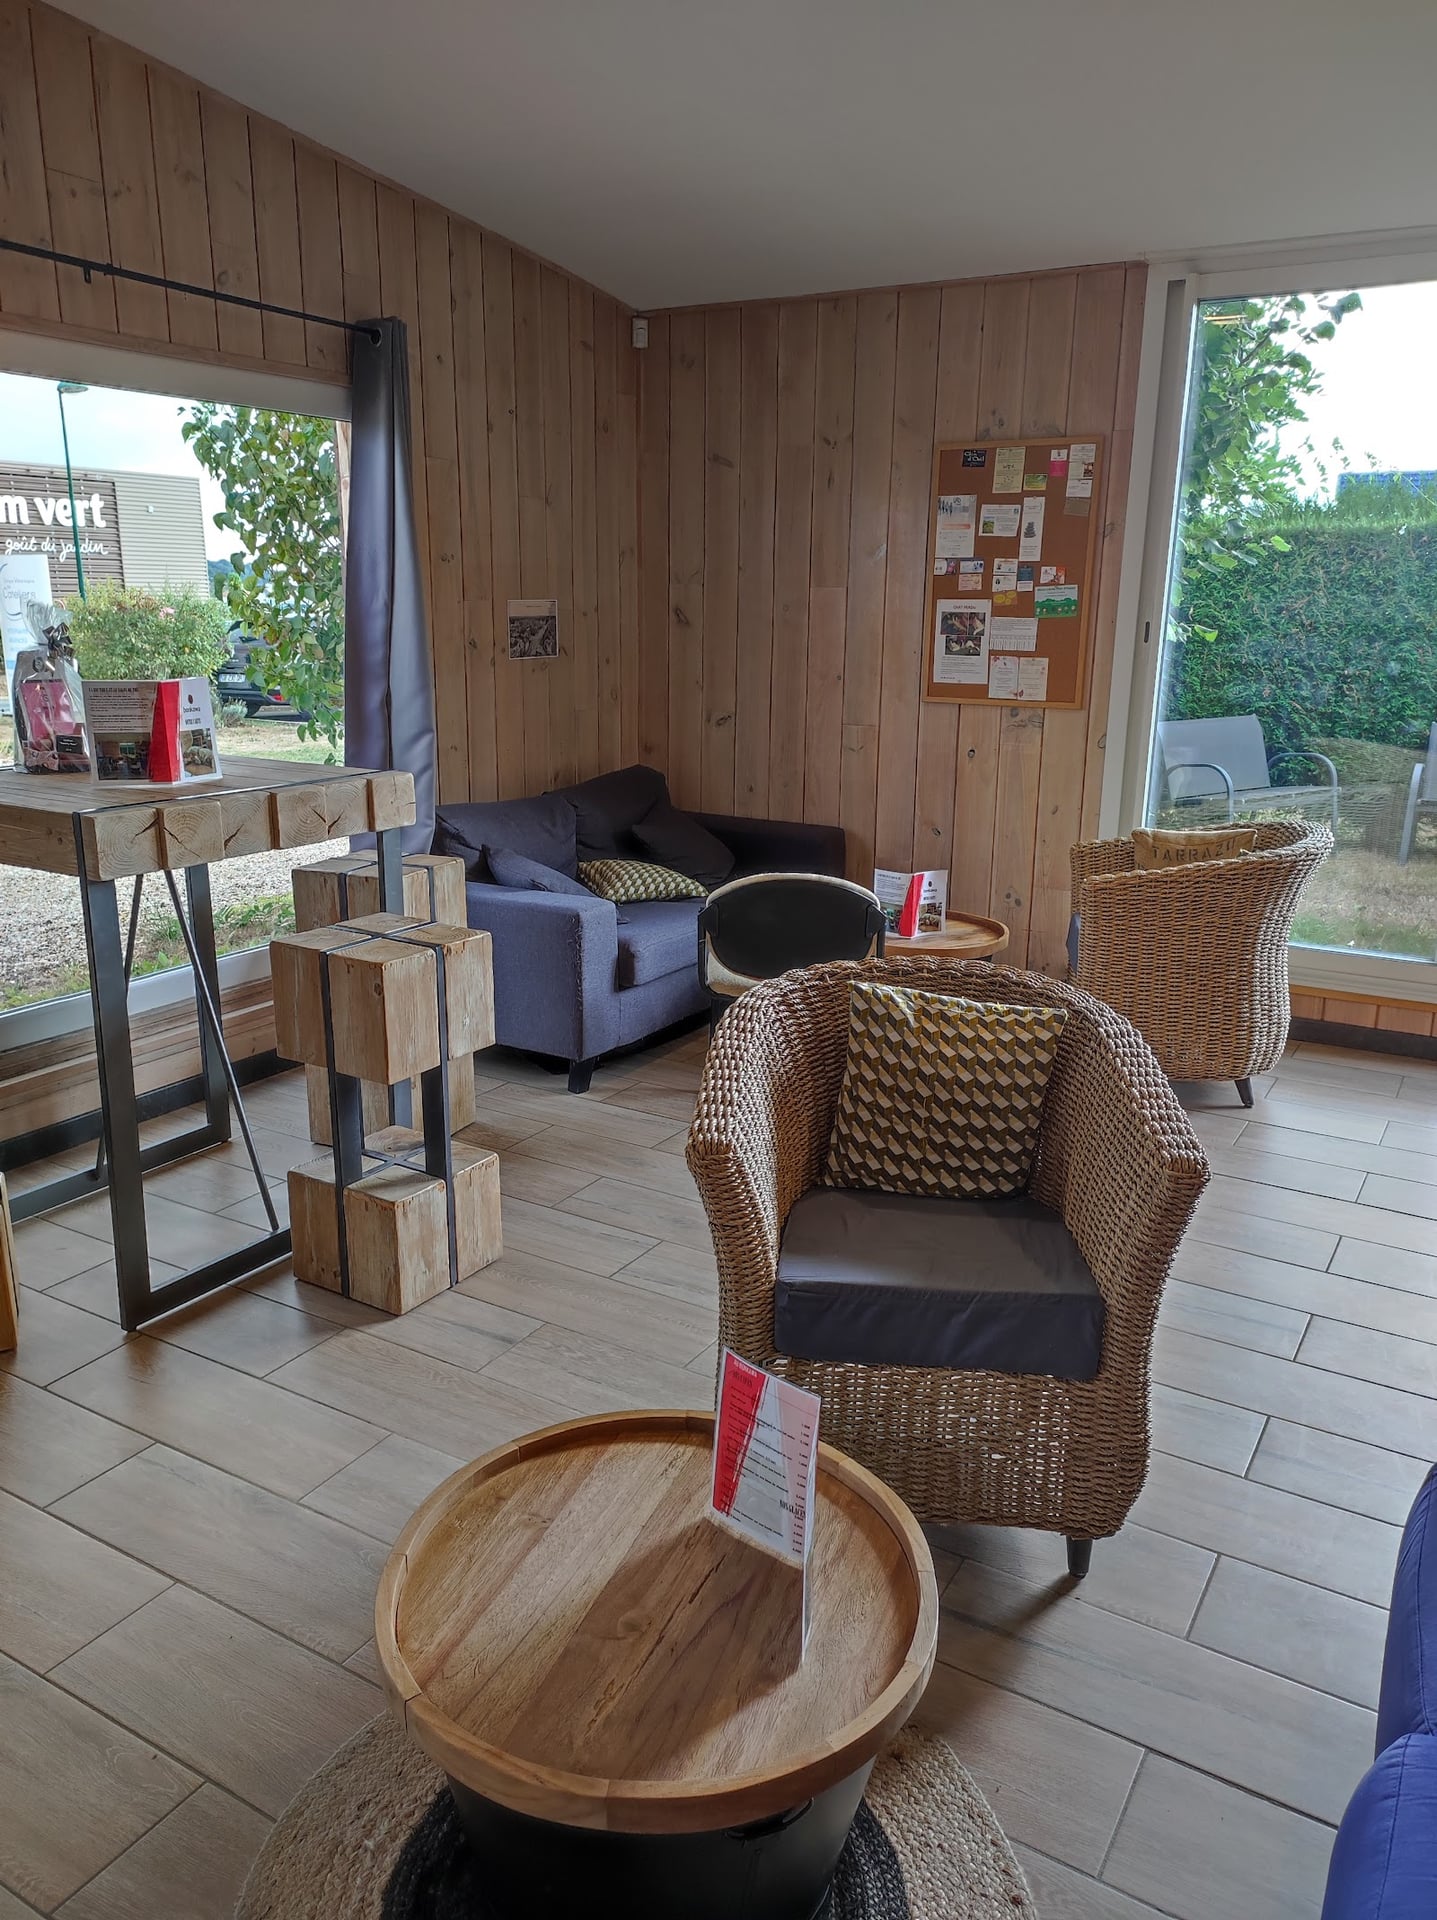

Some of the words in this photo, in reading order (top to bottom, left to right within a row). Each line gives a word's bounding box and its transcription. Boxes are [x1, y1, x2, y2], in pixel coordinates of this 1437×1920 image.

[33, 493, 107, 528] vert
[5, 535, 37, 555] goût
[41, 536, 56, 552] du
[60, 537, 109, 562] jadin
